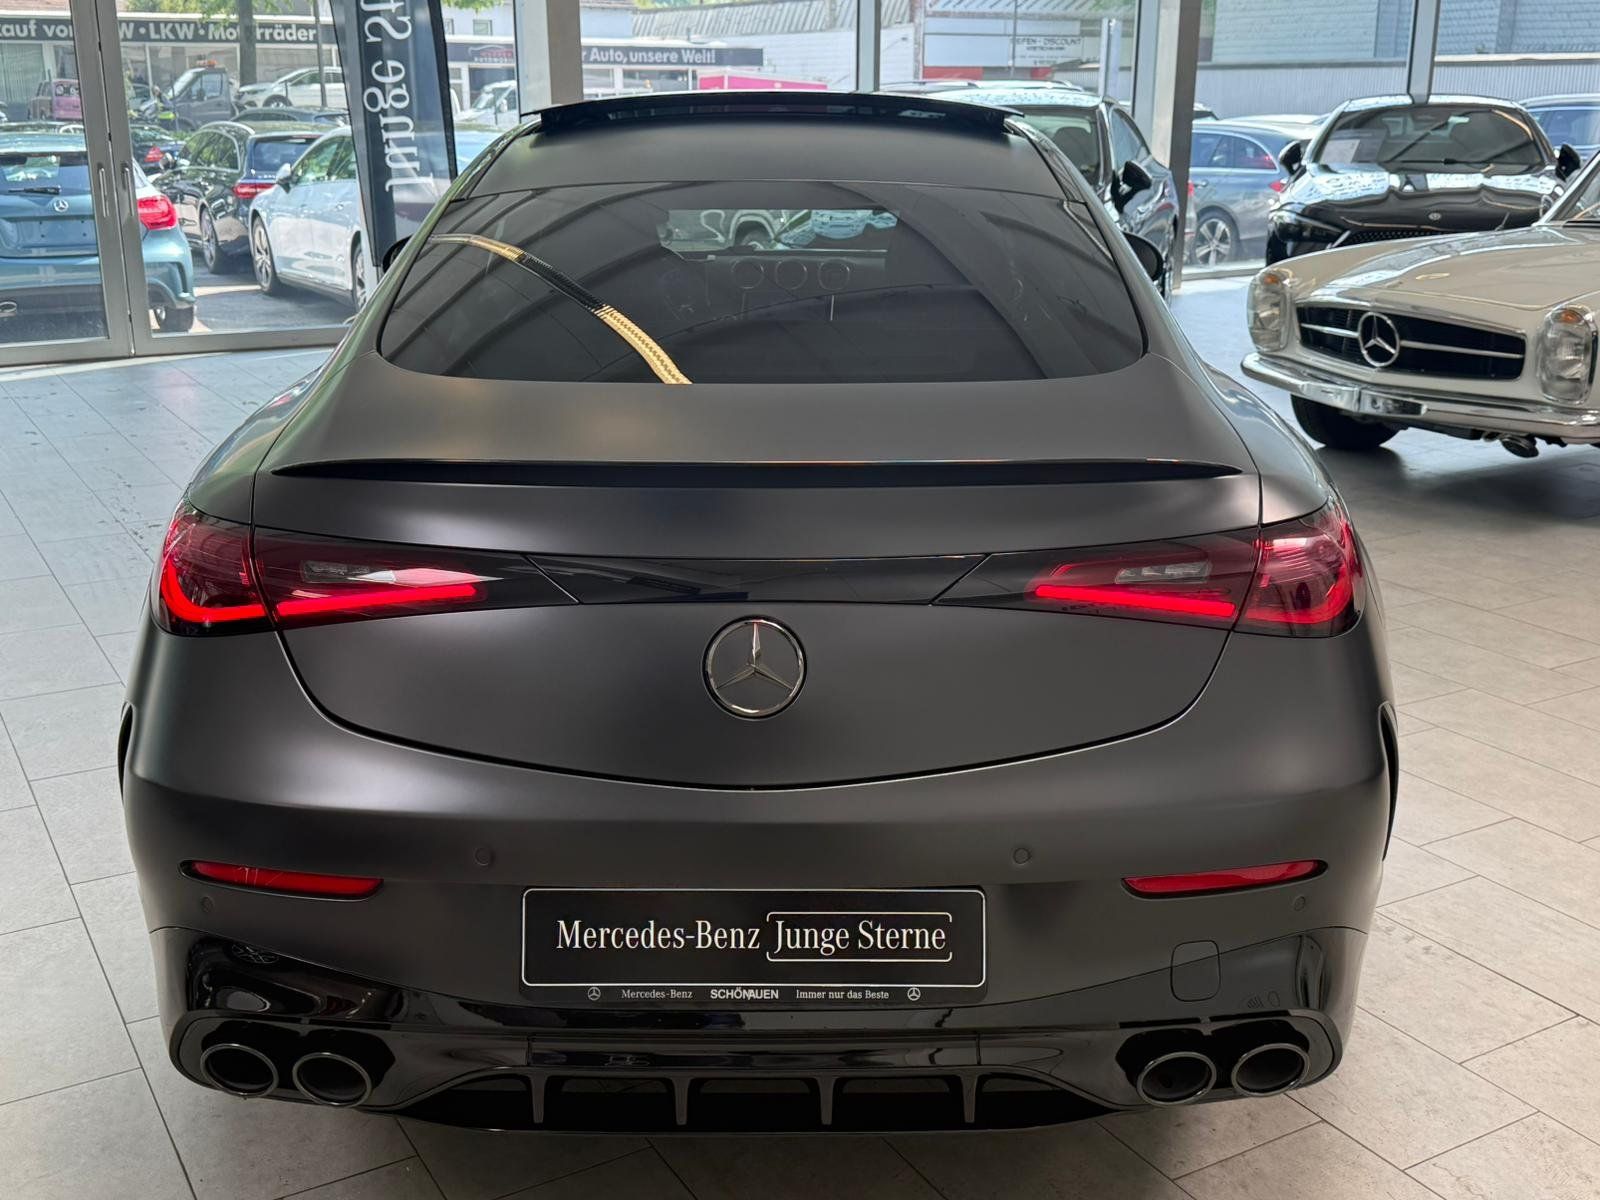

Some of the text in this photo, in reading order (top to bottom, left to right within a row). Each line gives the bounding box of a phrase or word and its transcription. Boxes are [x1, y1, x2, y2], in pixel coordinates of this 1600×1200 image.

[148, 22, 195, 40] LKW
[589, 47, 628, 63] Auto,
[629, 51, 679, 63] unsere
[556, 919, 947, 957] Mercedes-Benz Junge Sterne
[621, 989, 693, 999] Mercedes-Benz
[796, 989, 890, 999] Immer nur das Beste
